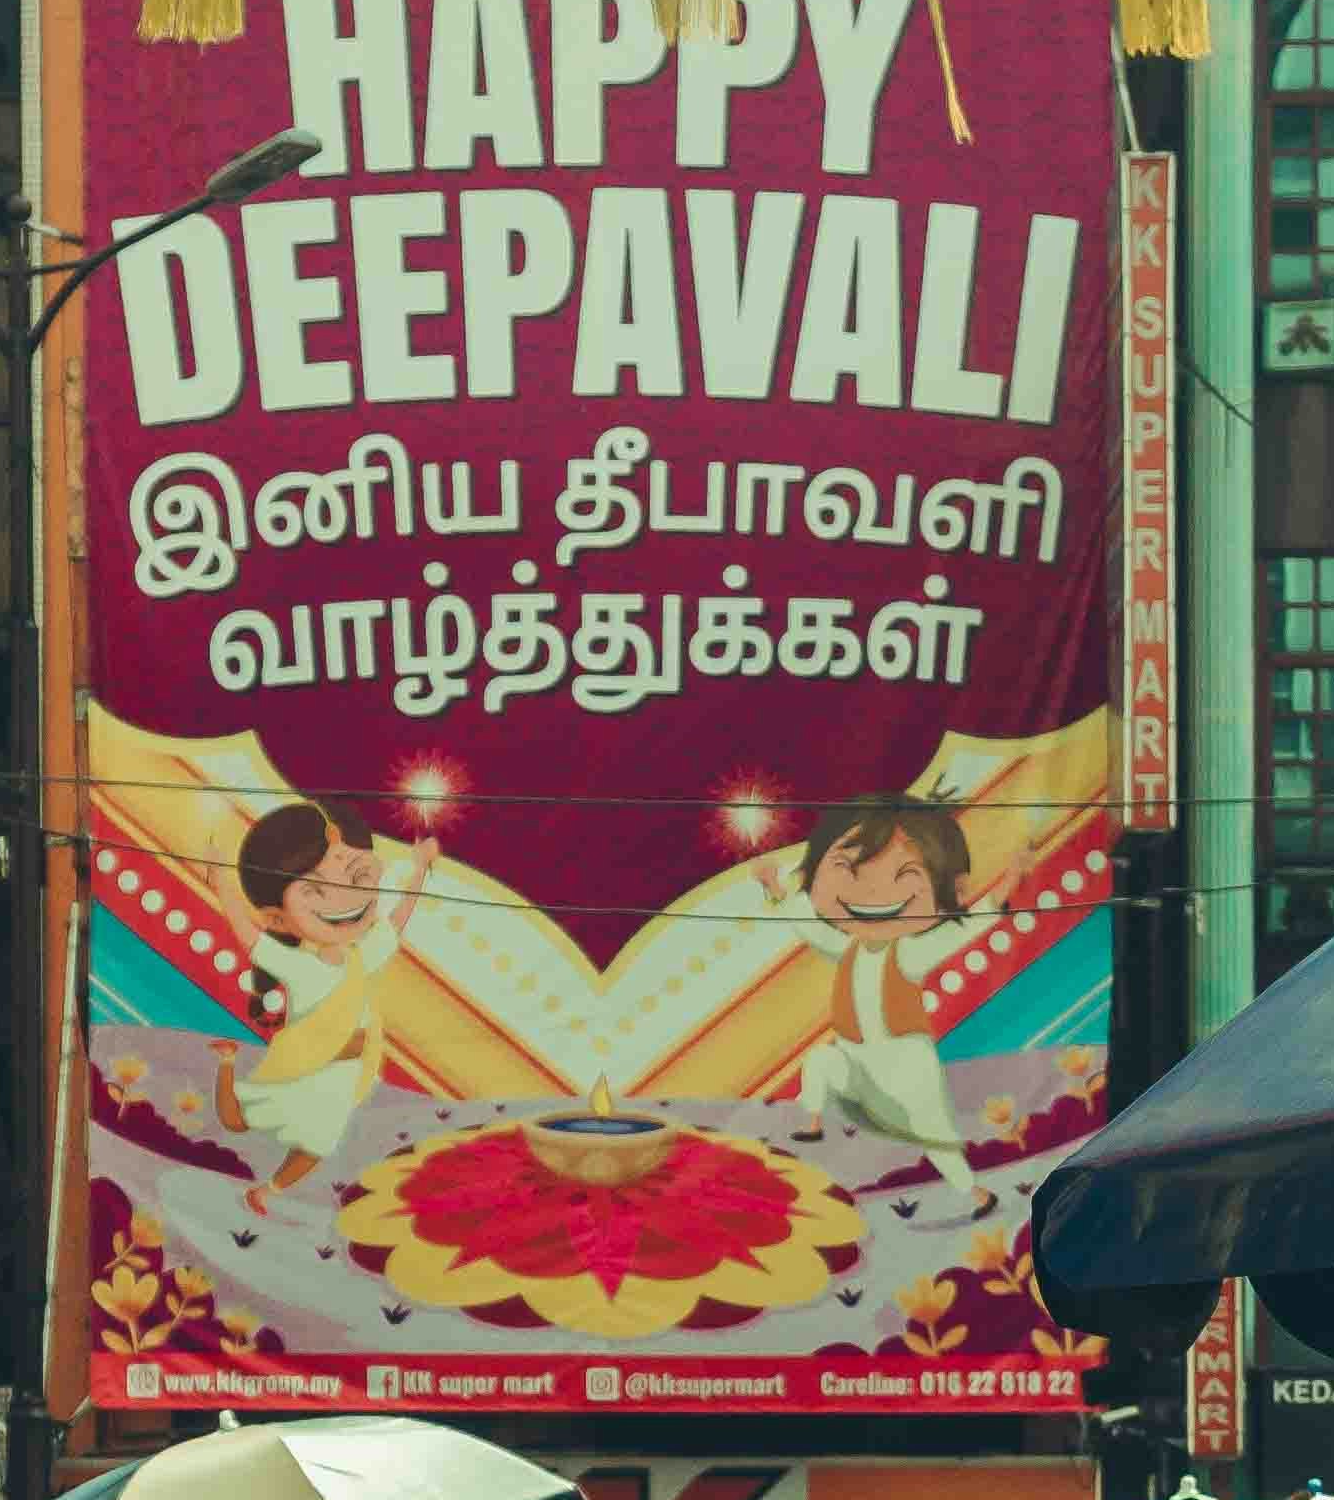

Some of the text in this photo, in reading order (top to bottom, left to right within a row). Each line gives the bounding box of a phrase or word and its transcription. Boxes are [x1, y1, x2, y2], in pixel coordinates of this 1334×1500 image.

[110, 186, 1079, 427] DEEPAVALI
[127, 426, 1063, 598] இனிய தீபாவளி
[208, 560, 985, 717] வாழ்த்துக்கள்
[1130, 599, 1166, 822] MART
